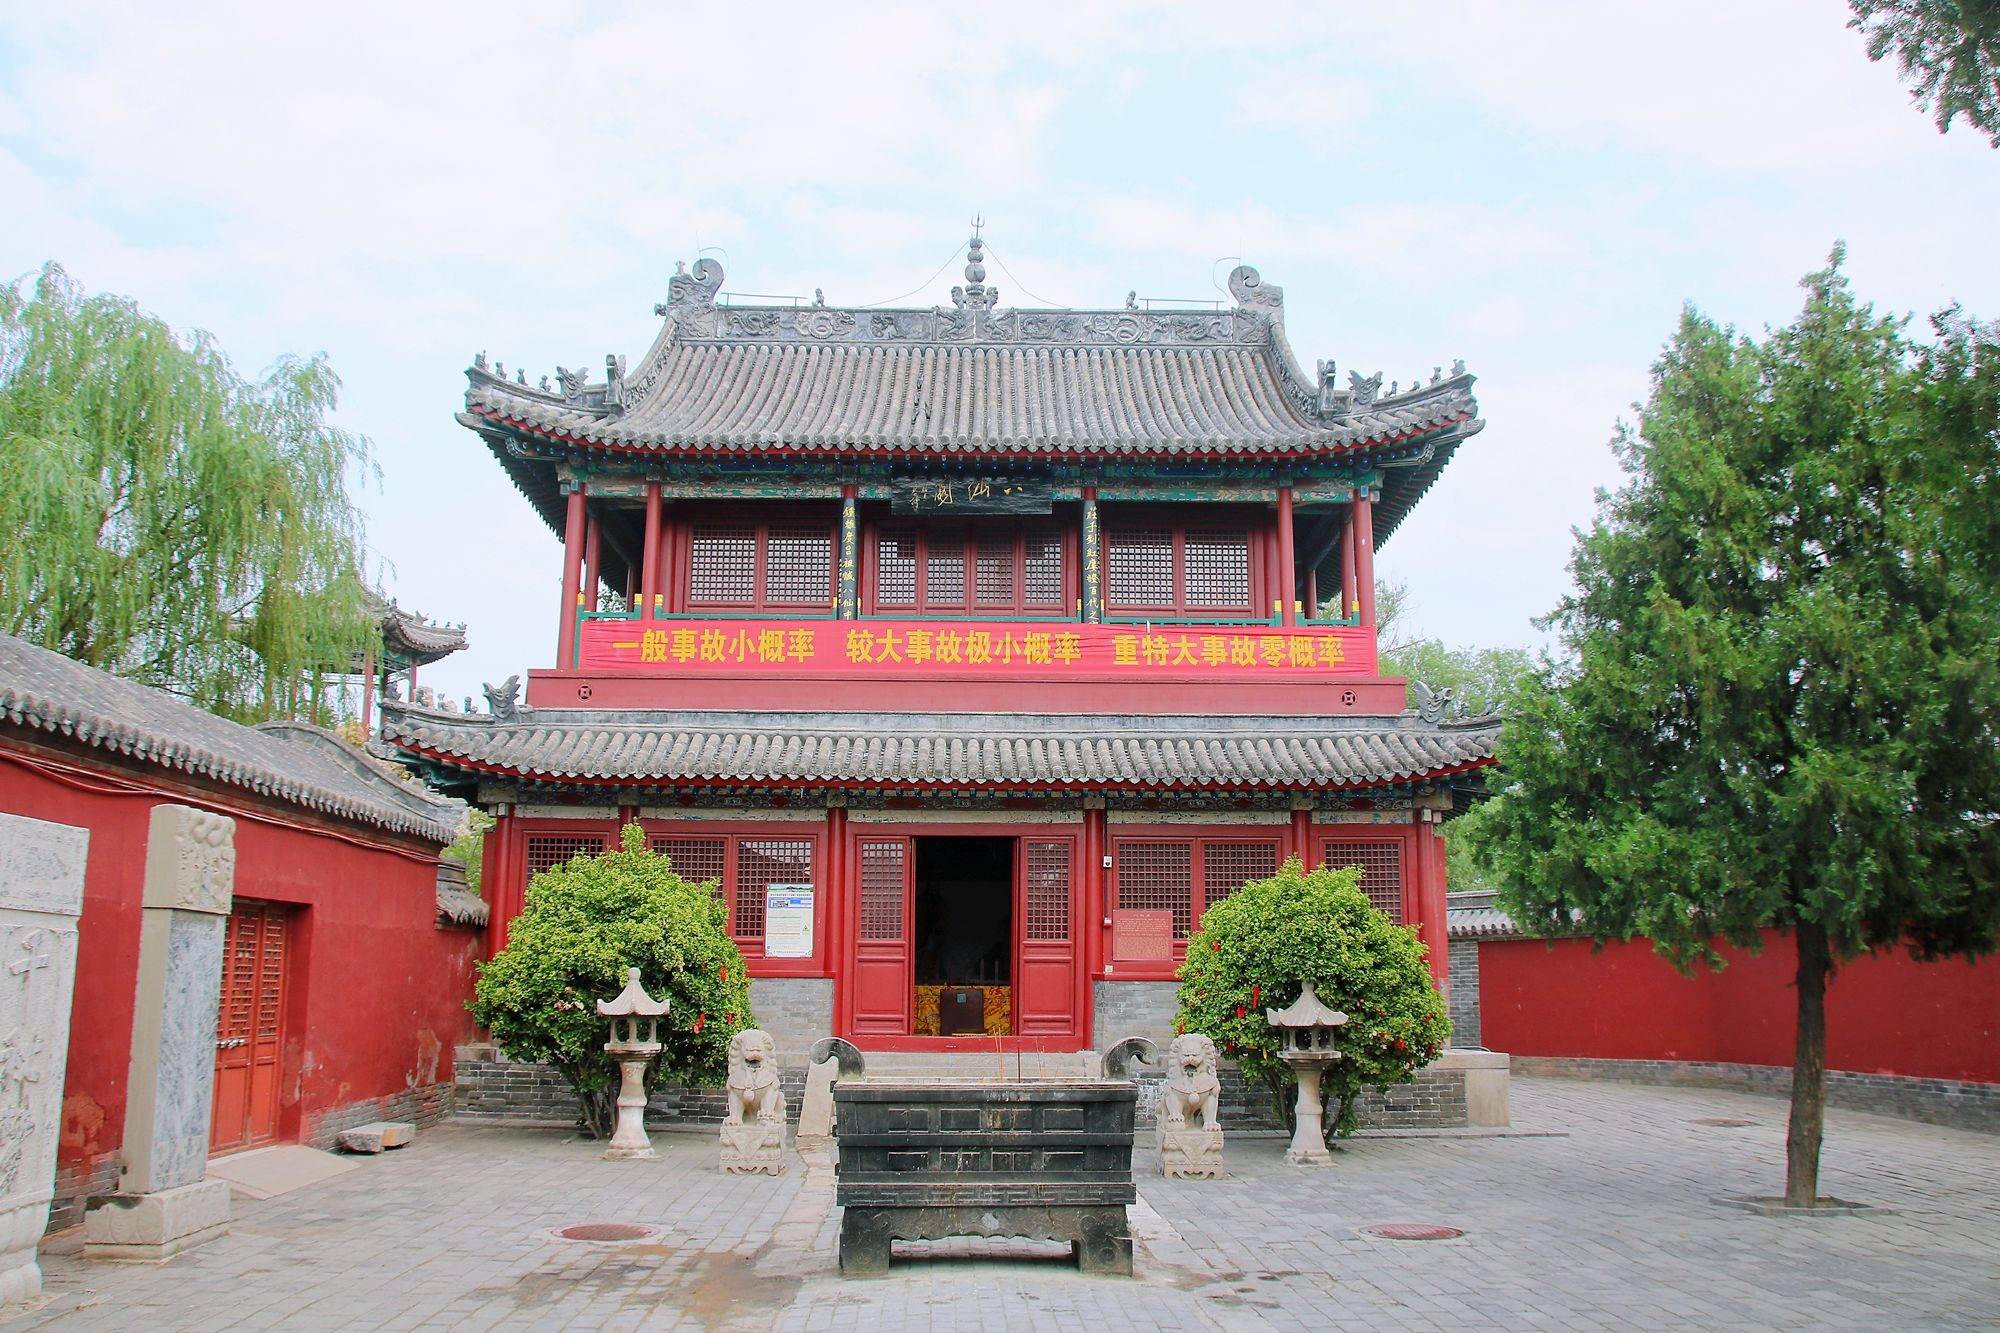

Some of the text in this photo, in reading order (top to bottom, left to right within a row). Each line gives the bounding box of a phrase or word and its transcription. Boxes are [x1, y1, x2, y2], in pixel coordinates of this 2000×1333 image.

[612, 628, 1344, 668] 一般事故小概率 较大事故极小概率 重特大事故零概率
